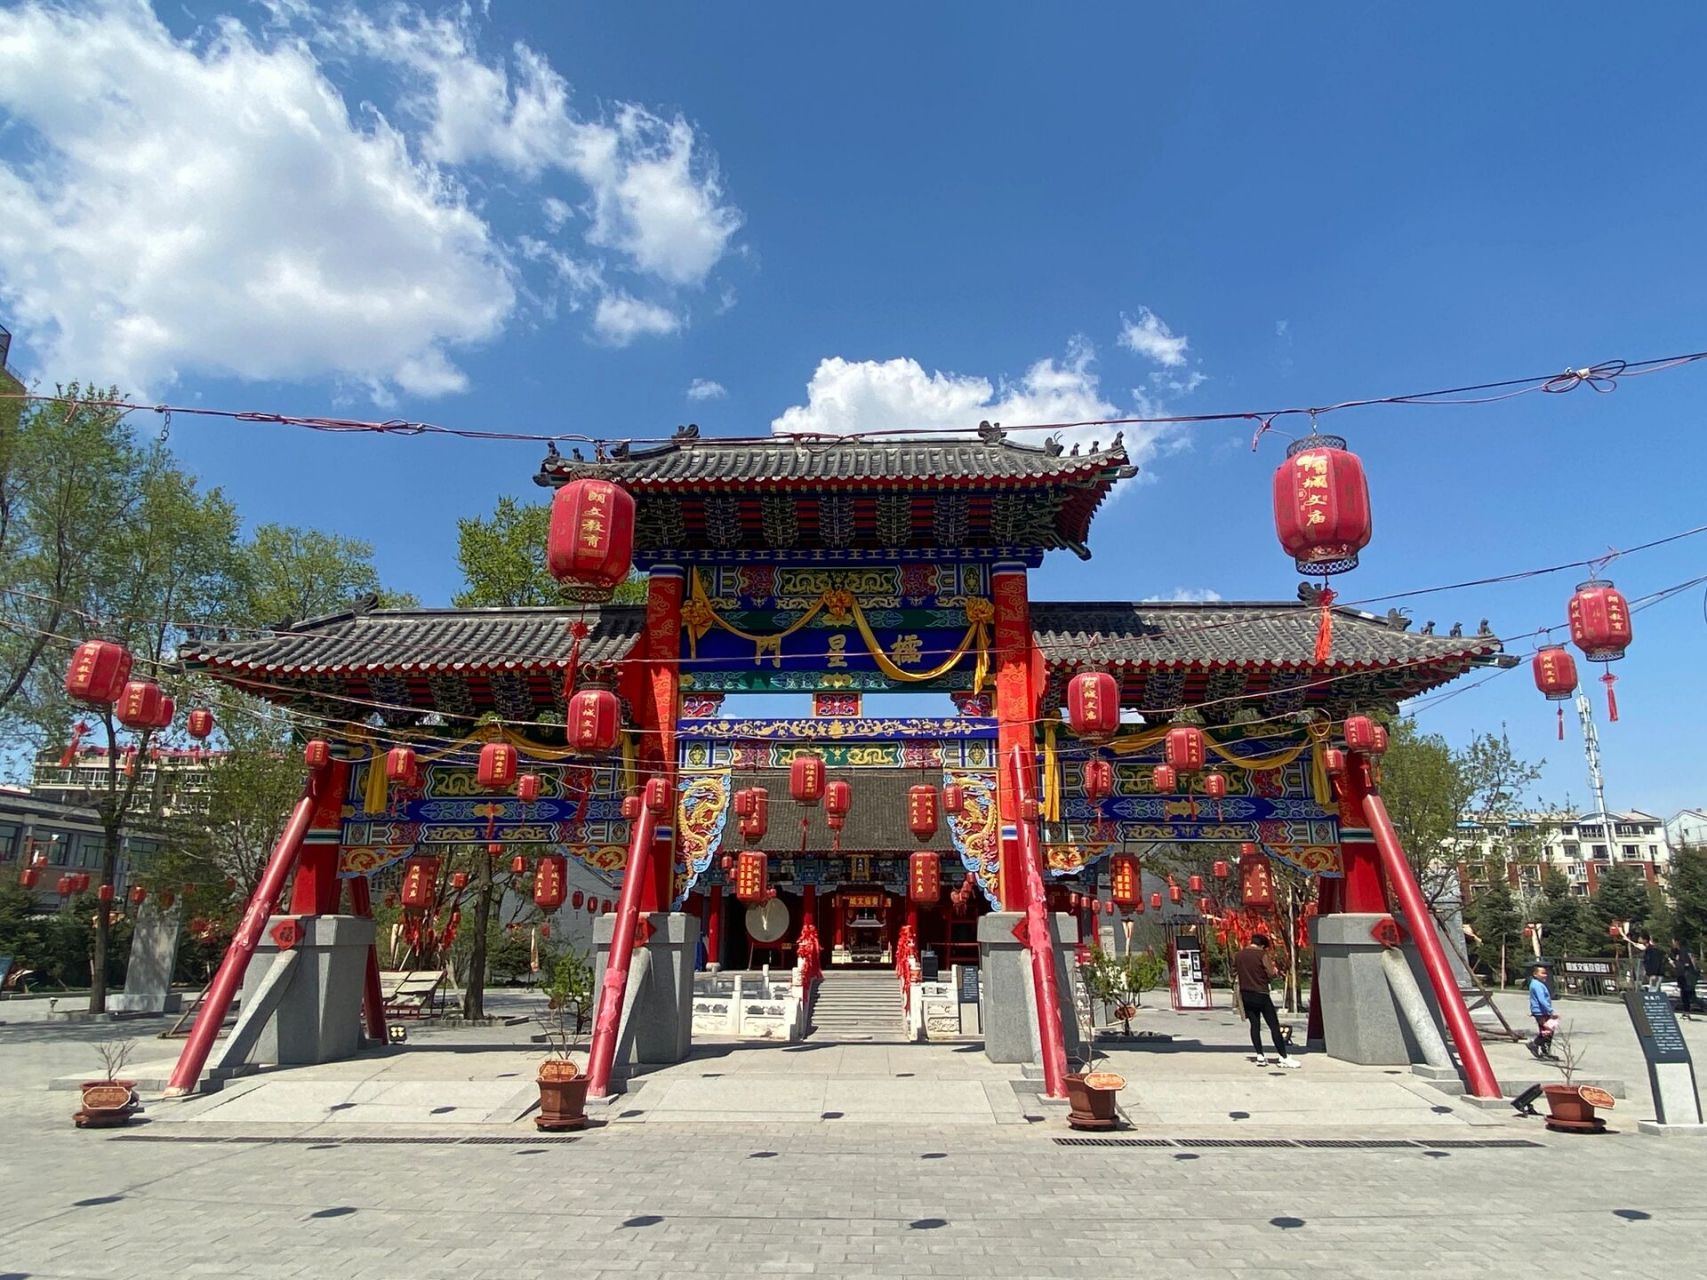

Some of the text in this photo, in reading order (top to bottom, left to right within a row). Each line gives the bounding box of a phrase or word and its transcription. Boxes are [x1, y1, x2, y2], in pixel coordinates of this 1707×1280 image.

[1296, 453, 1328, 527] 阿城文庙
[582, 694, 598, 739] 阿城文庙
